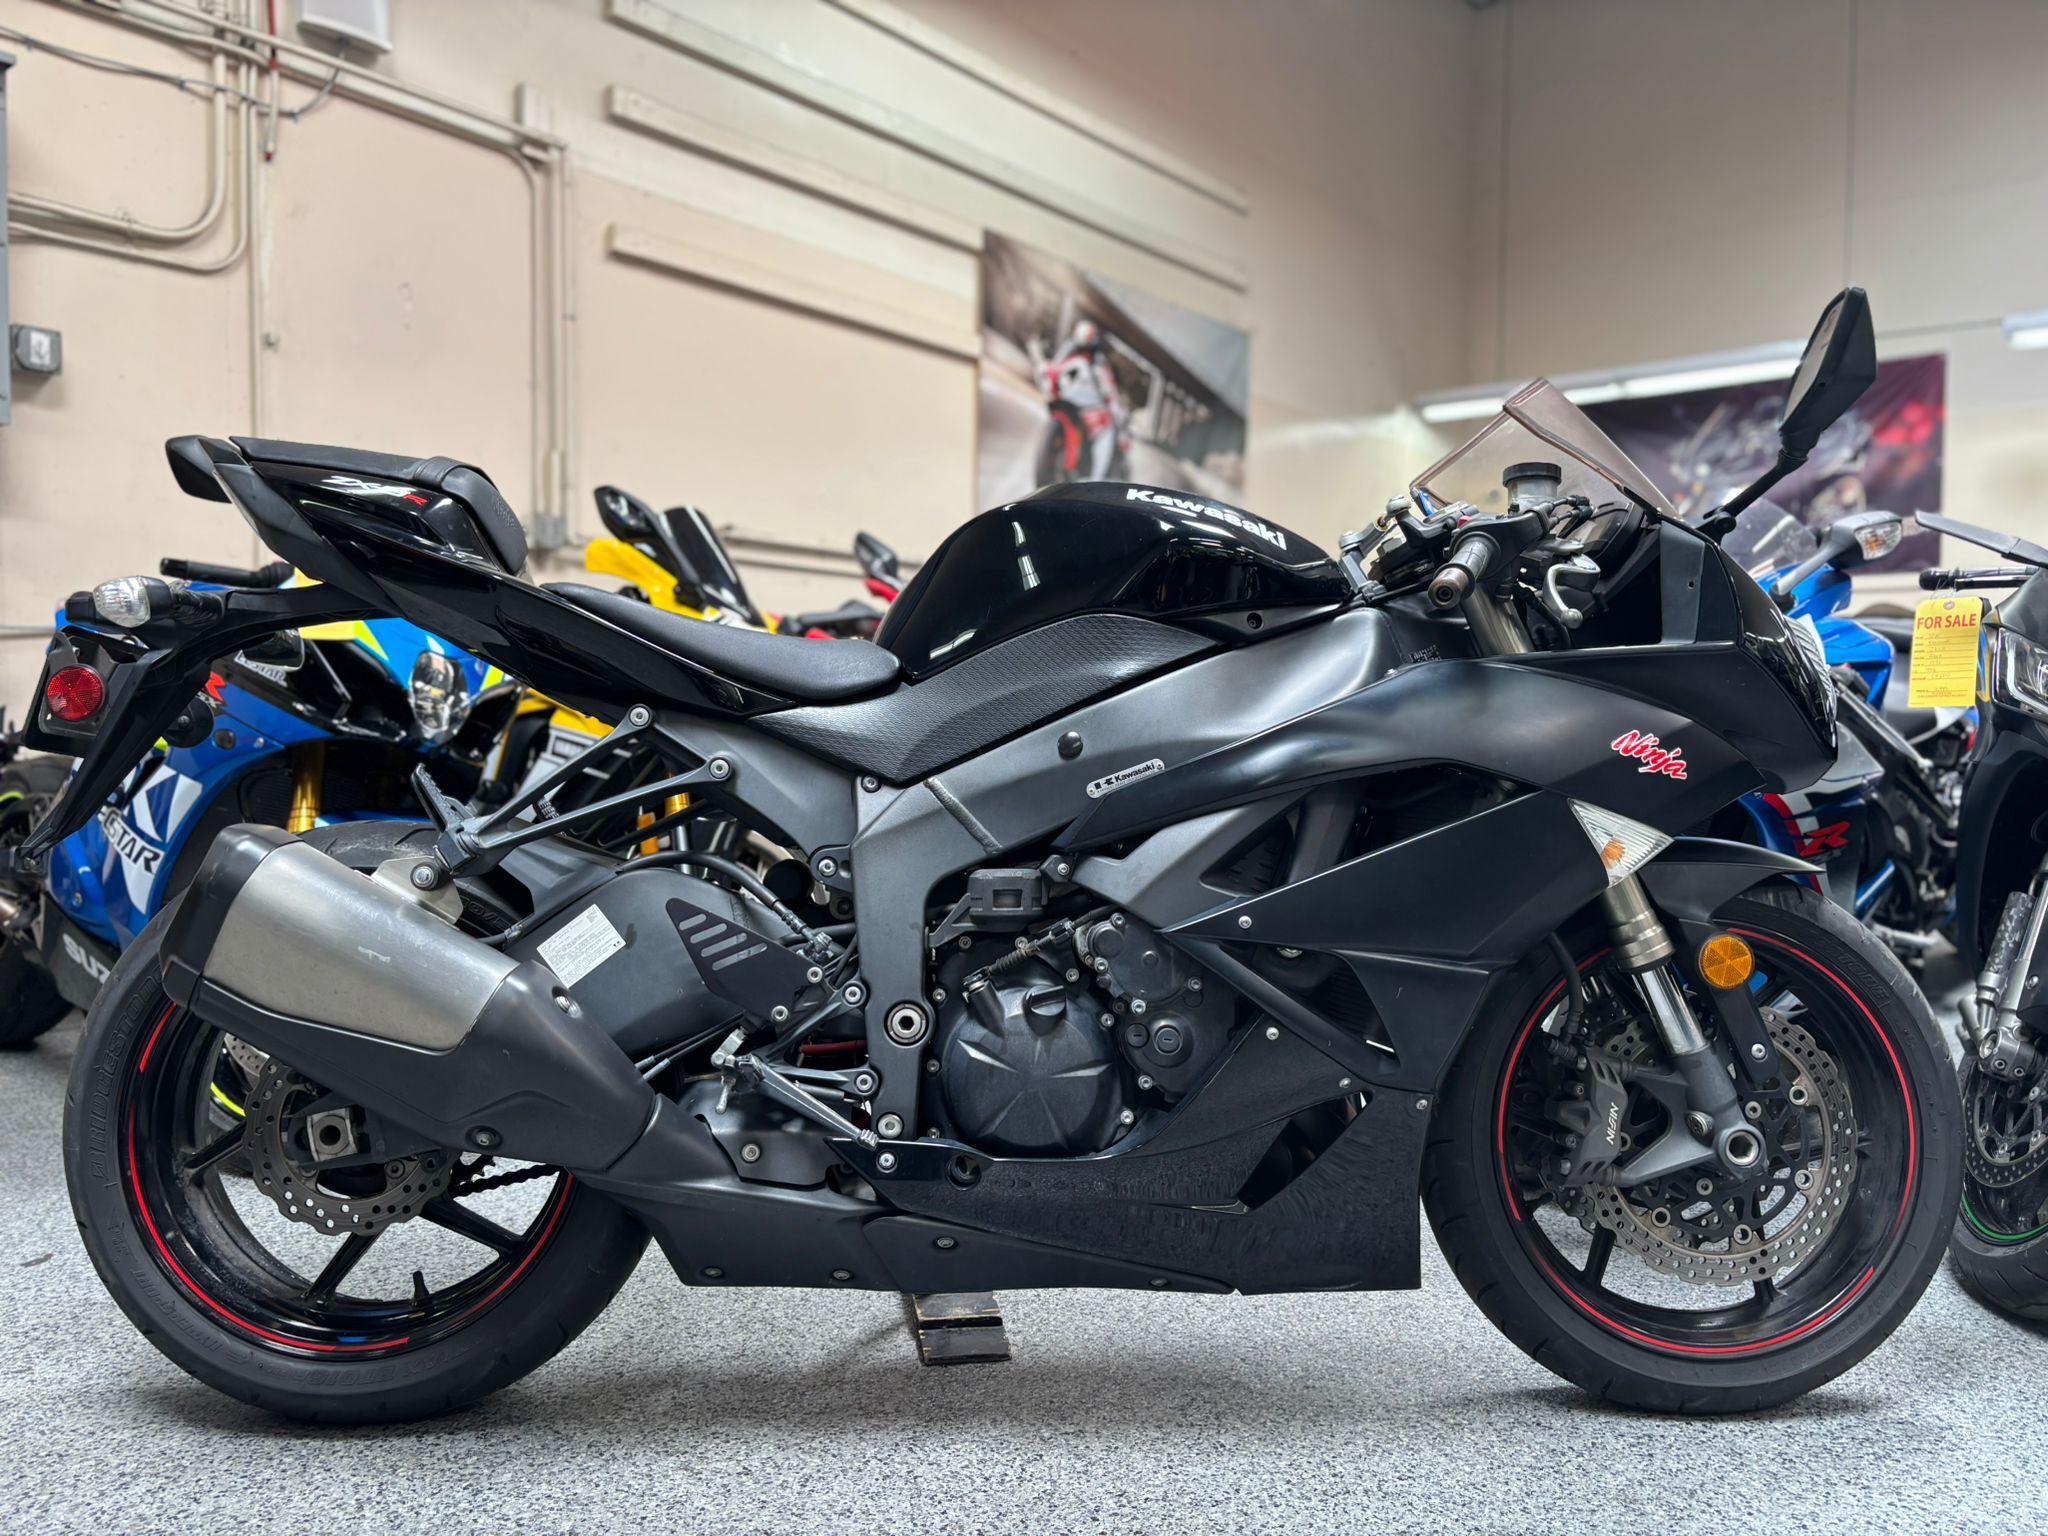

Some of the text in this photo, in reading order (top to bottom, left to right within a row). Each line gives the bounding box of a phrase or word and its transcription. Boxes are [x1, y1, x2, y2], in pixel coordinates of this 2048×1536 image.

[1126, 488, 1287, 550] Kawasaki
[1917, 613, 1977, 630] FOR SALE
[1114, 762, 1156, 783] Kawasaki
[1611, 730, 1687, 780] Ninja
[62, 932, 110, 985] SUZ
